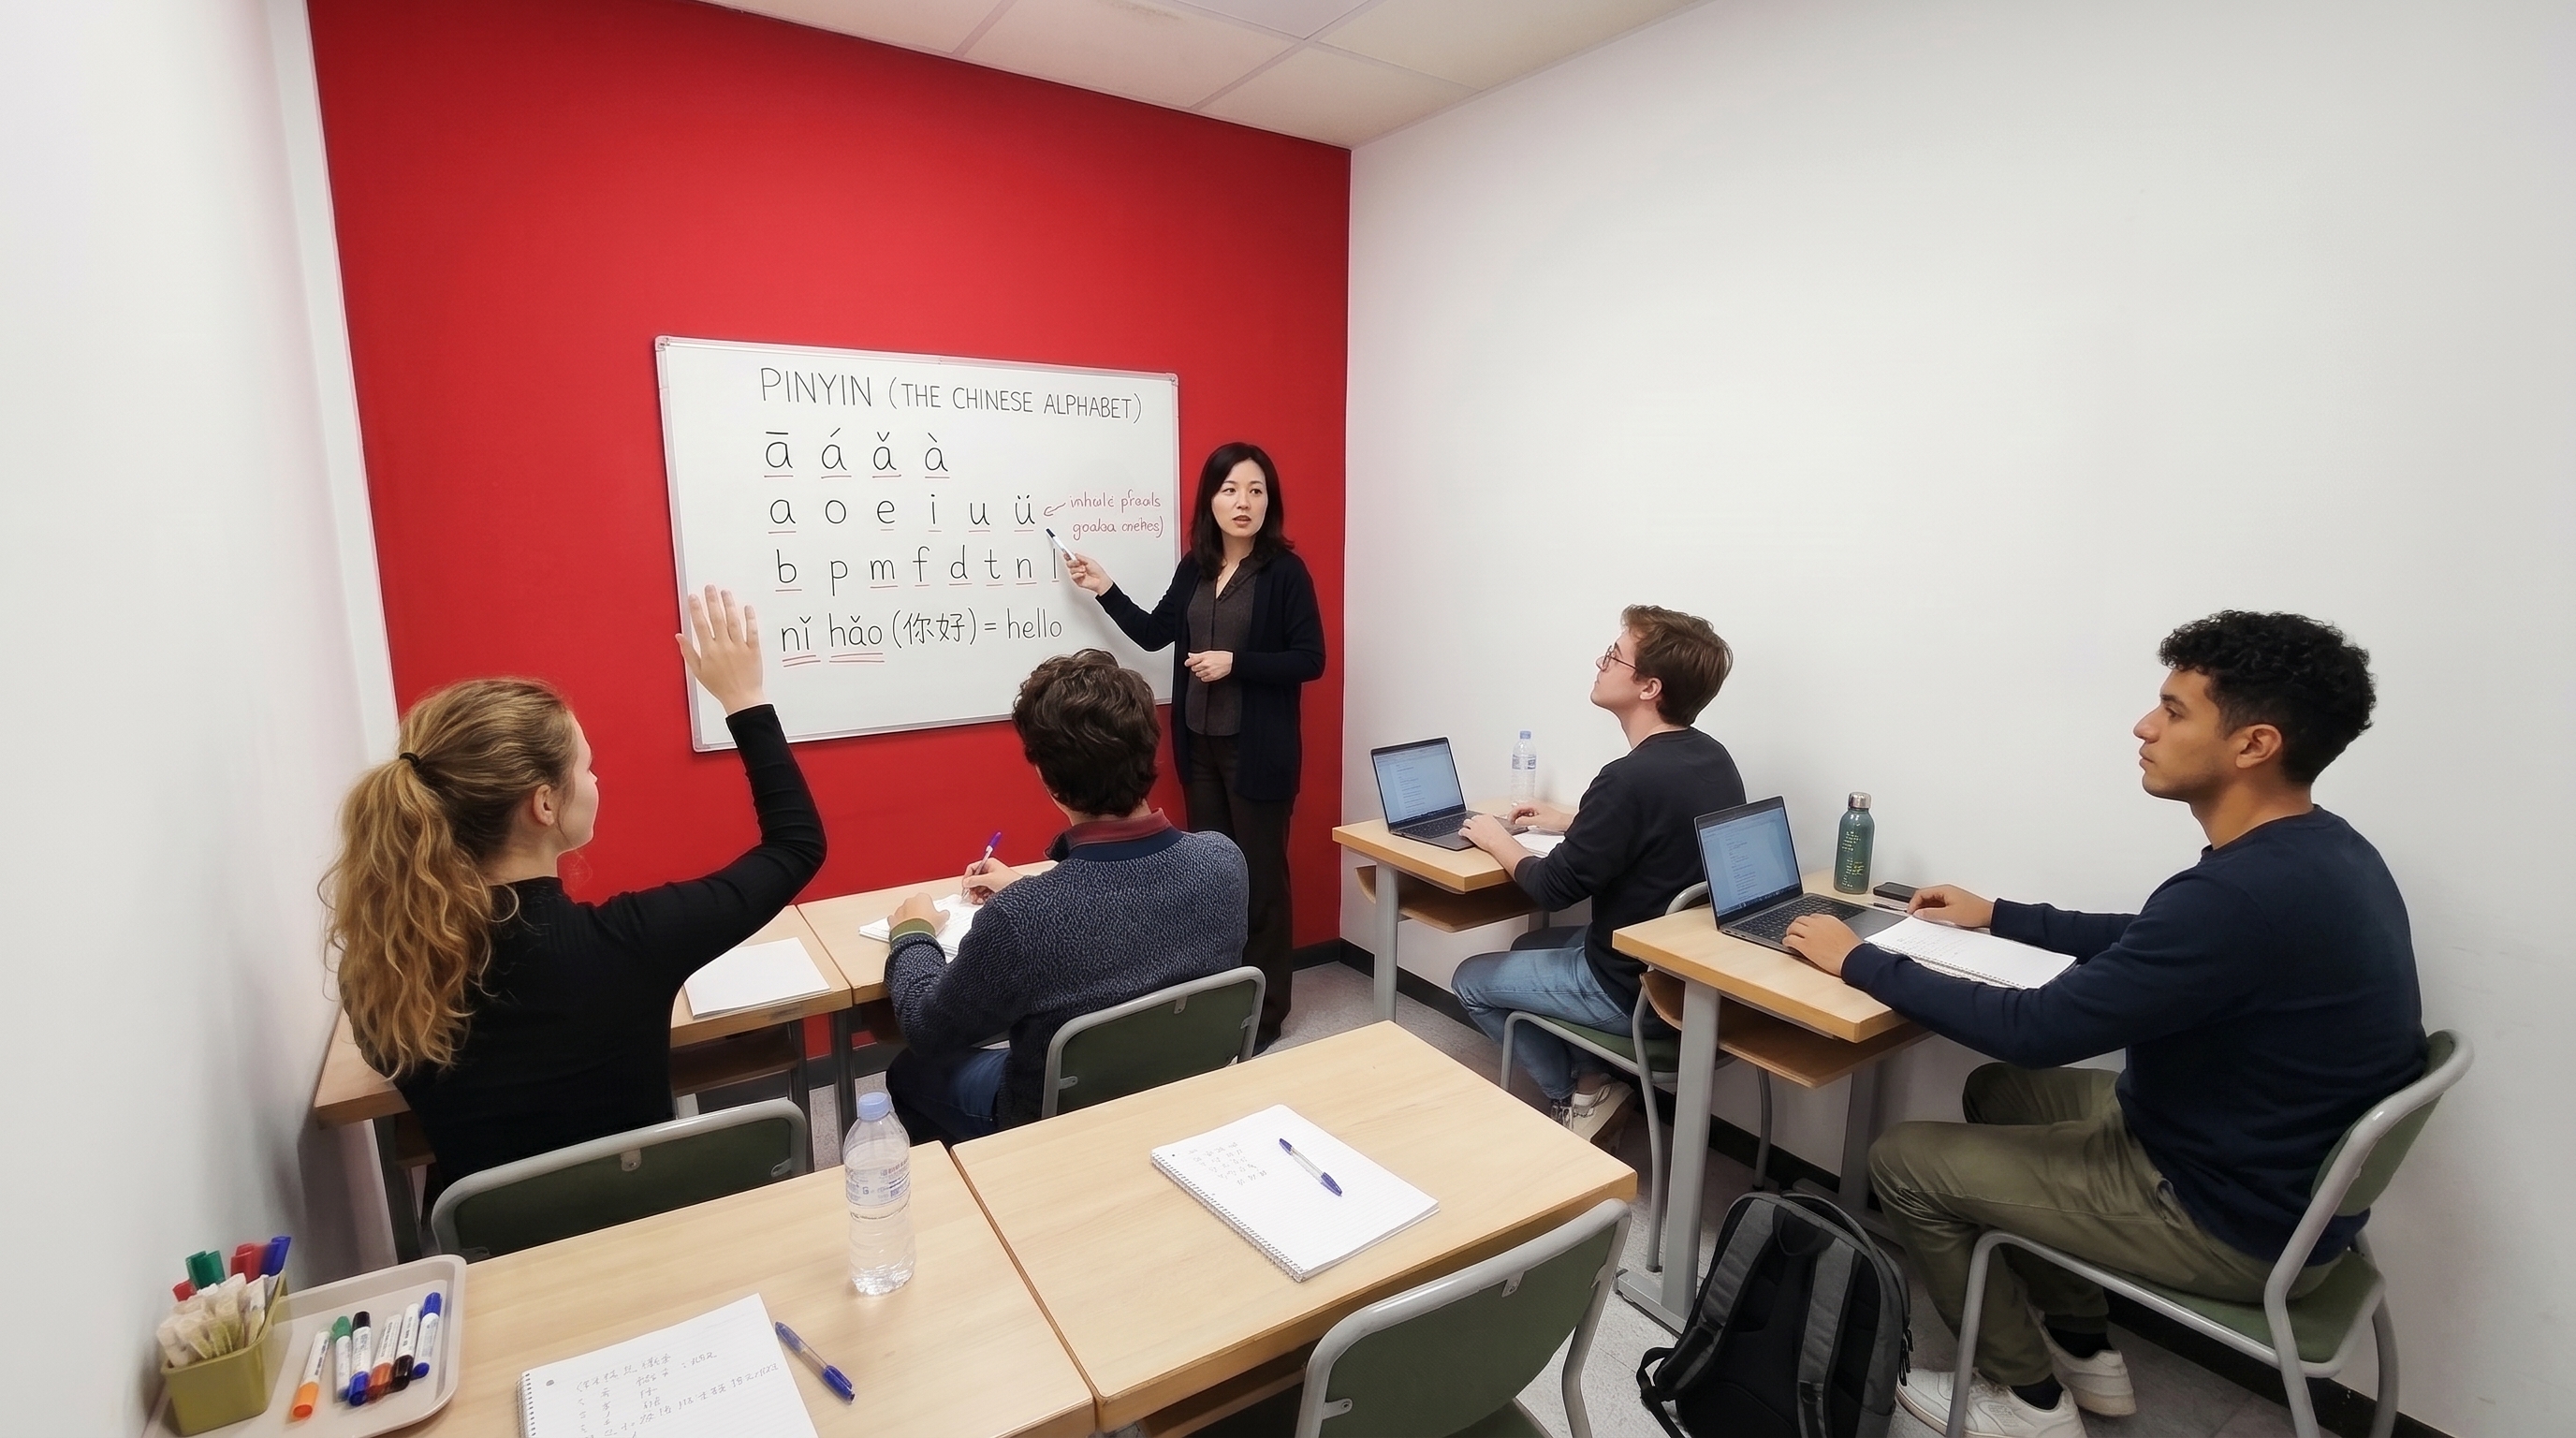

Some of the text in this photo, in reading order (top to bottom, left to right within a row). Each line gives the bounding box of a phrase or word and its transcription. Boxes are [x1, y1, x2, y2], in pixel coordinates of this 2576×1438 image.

[760, 367, 1142, 424] PINYIN (THE CHINESE ALPHABET)
[765, 427, 949, 472] ā á ǎ à
[769, 493, 1036, 526] a o e i u ü
[776, 549, 798, 584] b
[829, 560, 848, 597] p
[870, 559, 896, 580] m
[912, 545, 930, 583] f
[949, 544, 969, 580] d
[984, 549, 1002, 580] t
[1016, 558, 1032, 580] n
[781, 615, 812, 653] nǐ
[828, 612, 884, 648] hǎo
[892, 607, 977, 650] (你好)
[1006, 607, 1063, 640] hello
